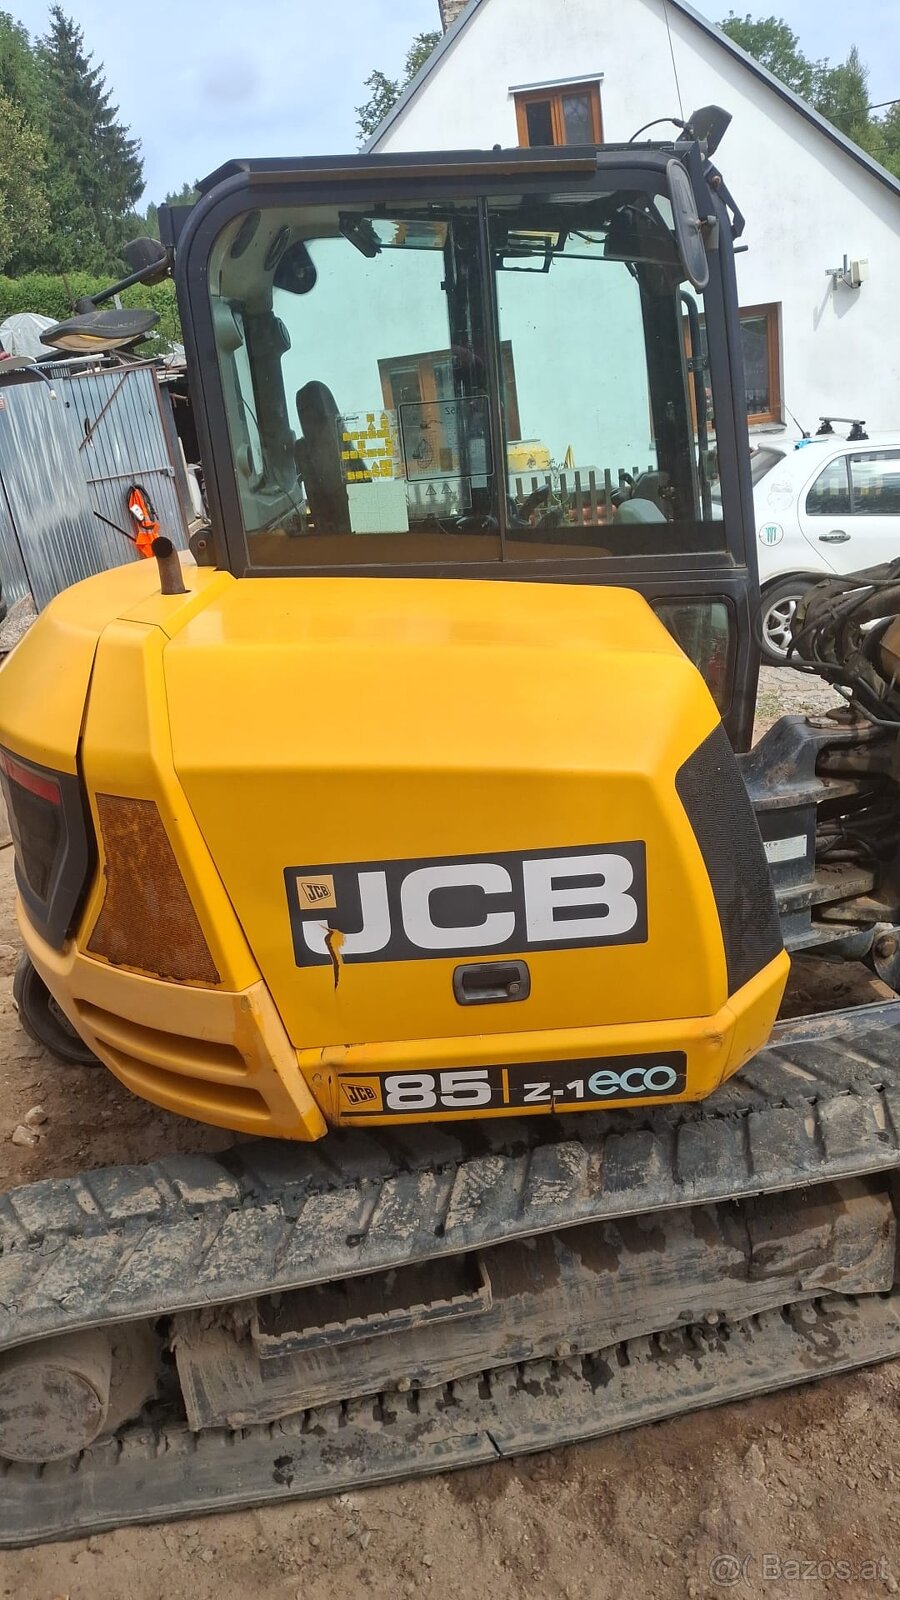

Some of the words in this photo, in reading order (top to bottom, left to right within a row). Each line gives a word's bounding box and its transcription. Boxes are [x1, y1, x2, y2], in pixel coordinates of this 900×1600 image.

[302, 853, 638, 954] JCB
[304, 882, 330, 900] JCB
[347, 1083, 375, 1103] JCB
[384, 1070, 492, 1110] 85
